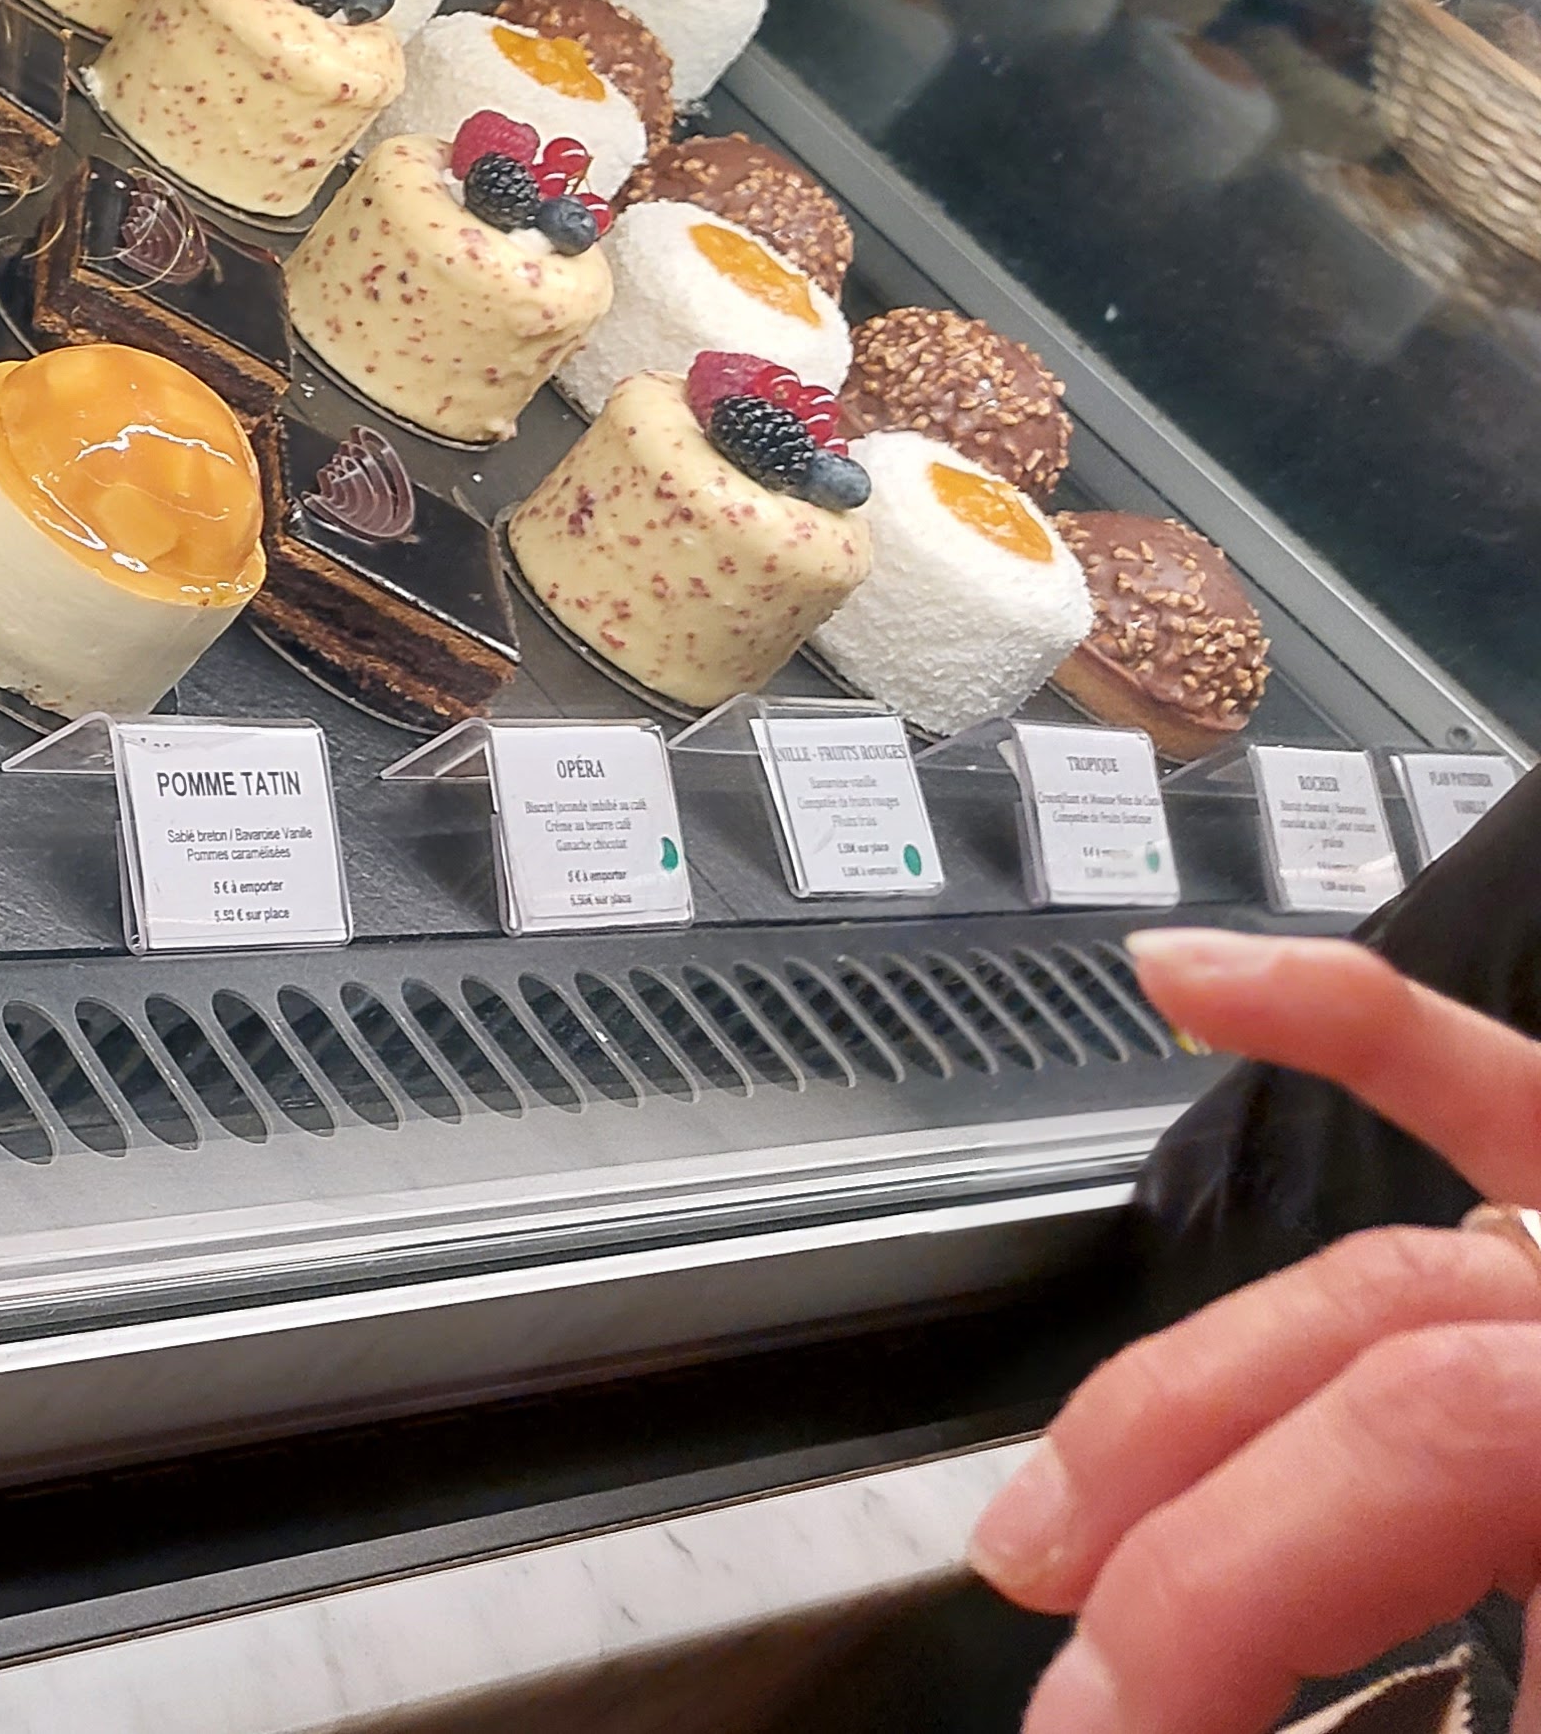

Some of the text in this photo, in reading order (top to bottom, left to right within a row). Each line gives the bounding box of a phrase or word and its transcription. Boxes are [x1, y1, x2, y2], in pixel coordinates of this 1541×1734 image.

[817, 745, 861, 762] FRUITS
[860, 744, 908, 760] ROUGES
[556, 754, 606, 779] OPÉRA
[1066, 756, 1119, 775] TROPIQUE
[156, 770, 302, 797] POMME TATIN
[167, 829, 195, 843] Sablé
[197, 829, 227, 842] breton
[235, 828, 281, 841] Bavaroise
[282, 826, 313, 840] Vanille
[187, 845, 291, 862] Pommes caramélisées
[214, 879, 283, 896] 5 € à emporter
[245, 909, 262, 921] sur
[265, 907, 290, 923] place
